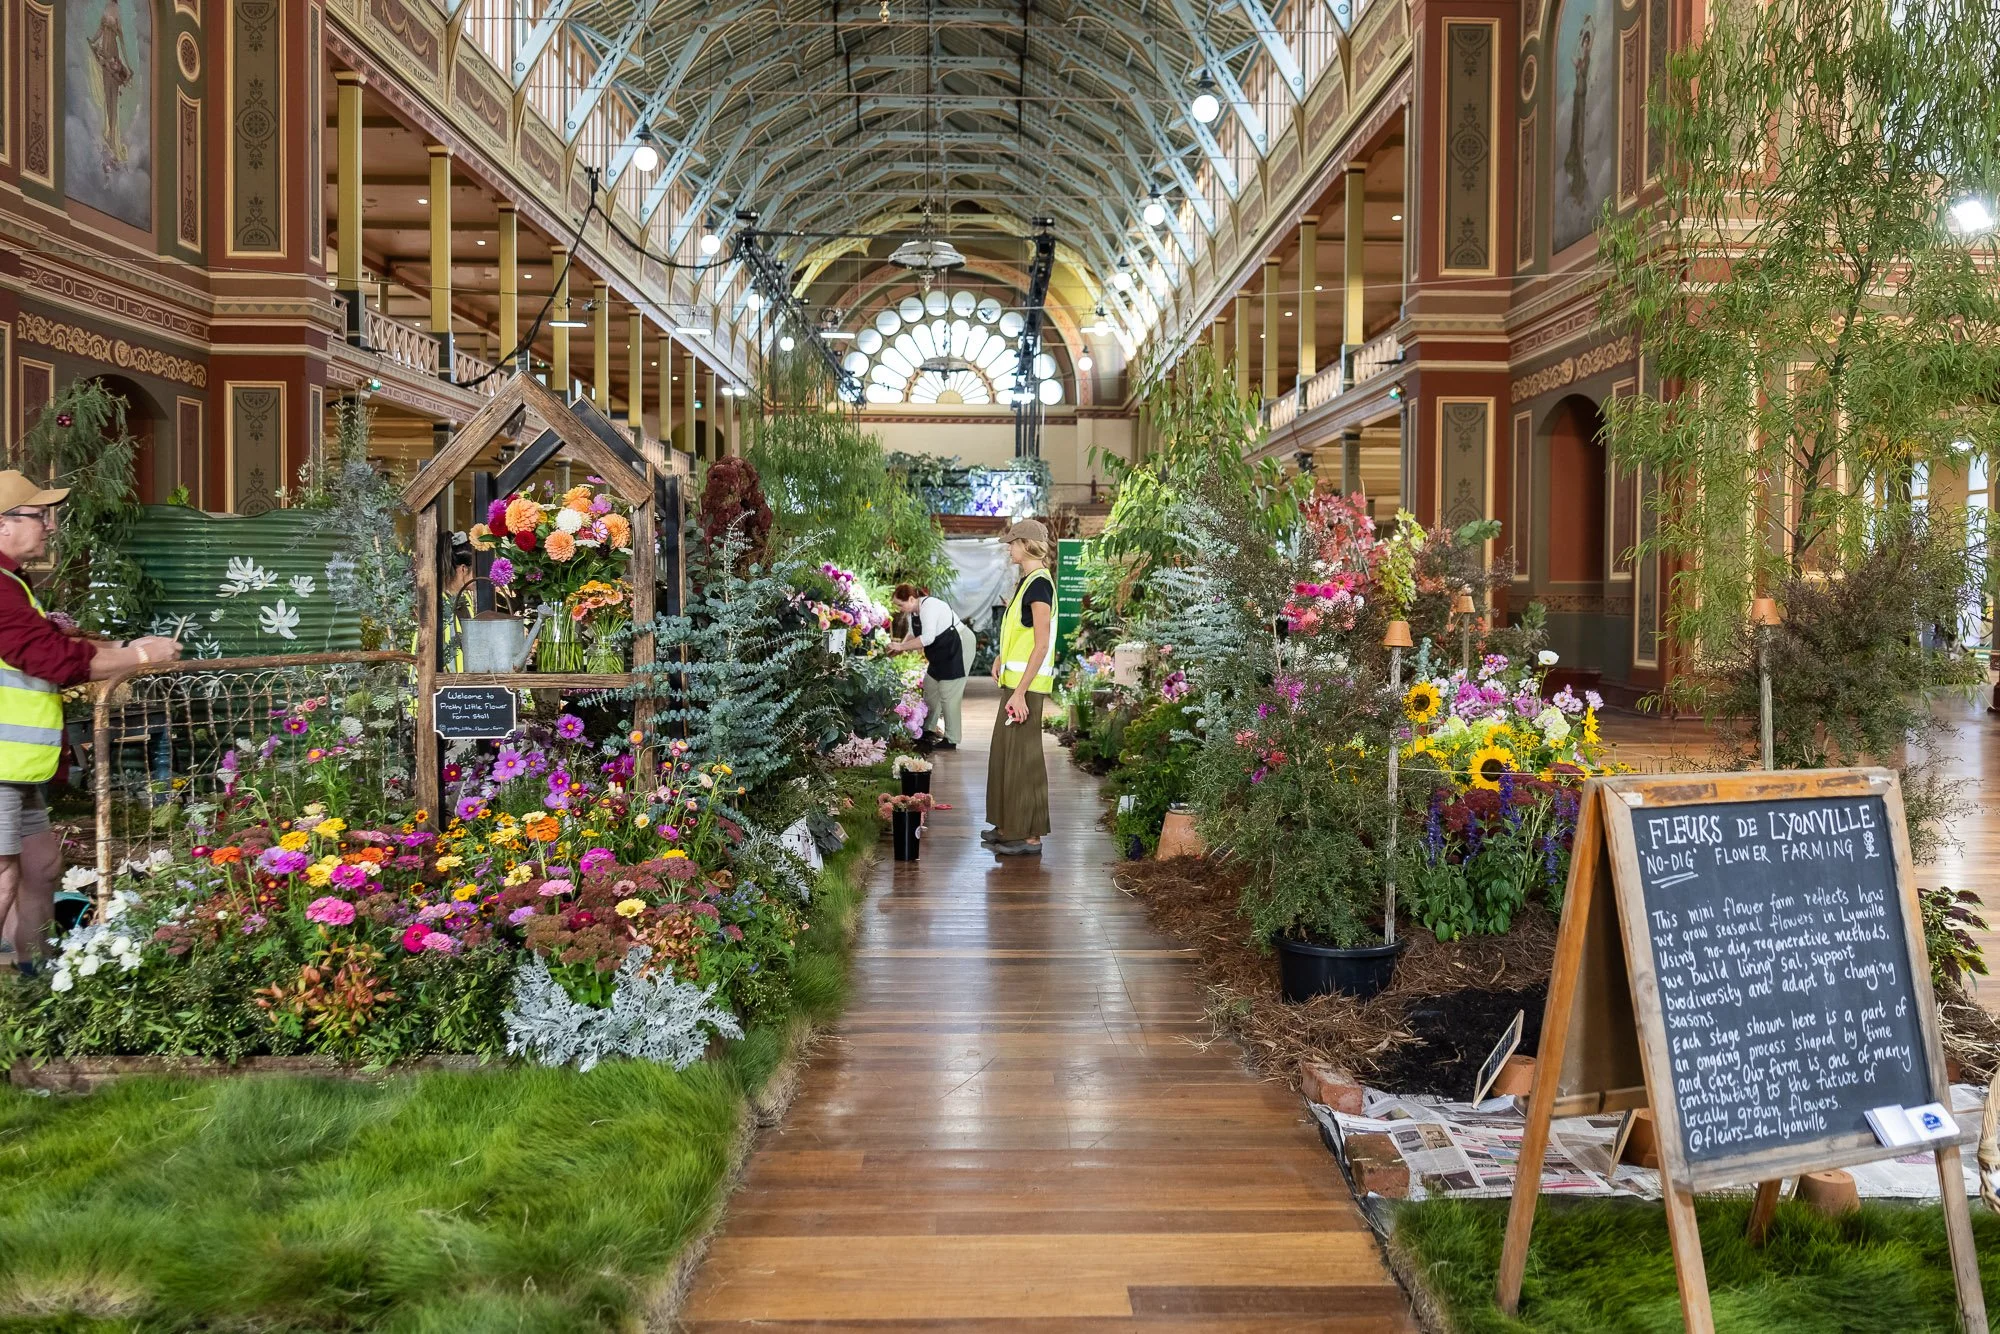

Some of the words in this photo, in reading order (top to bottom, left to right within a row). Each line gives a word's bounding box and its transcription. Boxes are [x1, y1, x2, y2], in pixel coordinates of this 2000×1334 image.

[439, 702, 463, 713] Pretty
[484, 702, 508, 710] Flower
[447, 691, 483, 700] Welcome
[486, 692, 495, 700] to
[1648, 814, 1723, 850] FLEURS
[1736, 818, 1758, 838] DE
[1768, 804, 1875, 841] LYONVILLE
[1714, 844, 1771, 866] FLOWER
[1781, 838, 1854, 863] FARMING
[1652, 909, 1678, 930] This
[1687, 899, 1714, 924] mini
[1722, 896, 1764, 919] flower
[1769, 892, 1795, 913] farm
[1803, 886, 1850, 906] reflects
[1857, 883, 1884, 904] how
[1653, 932, 1674, 947] we
[1682, 925, 1708, 958] grow
[1715, 916, 1763, 939] seasonal
[1769, 913, 1814, 934] flowers
[1822, 908, 1836, 924] in
[1840, 903, 1886, 929] Lyonville
[1660, 949, 1696, 970] Using
[1834, 922, 1890, 943] methods.
[1661, 974, 1684, 989] we
[1690, 959, 1729, 986] build
[1737, 957, 1775, 985] living
[1811, 944, 1855, 968] support
[1665, 982, 1742, 1010] biodiversity
[1748, 975, 1772, 998] and
[1782, 972, 1818, 996] adapt
[1824, 966, 1836, 985] to
[1844, 959, 1897, 991] changing
[1672, 1031, 1702, 1055] Each
[1709, 1026, 1741, 1051] stage
[1745, 1014, 1786, 1037] shown
[1790, 1009, 1817, 1031] here
[1825, 1005, 1837, 1026] is
[1844, 1009, 1855, 1024] a
[1861, 999, 1887, 1033] part
[1895, 995, 1908, 1018] of
[1675, 1058, 1690, 1073] an
[1696, 1047, 1741, 1078] ongoing
[1748, 1039, 1787, 1070] process
[1794, 1027, 1837, 1053] shaped
[1843, 1026, 1858, 1051] by
[1866, 1023, 1893, 1043] time
[1678, 1070, 1704, 1095] and
[1742, 1063, 1765, 1085] Our
[1768, 1056, 1802, 1081] farm
[1807, 1052, 1821, 1072] is
[1828, 1052, 1850, 1070] one
[1857, 1043, 1871, 1065] of
[1873, 1044, 1913, 1073] many
[1679, 1083, 1761, 1112] contributing
[1766, 1079, 1781, 1101] to
[1787, 1073, 1812, 1094] the
[1815, 1067, 1860, 1091] future
[1863, 1061, 1879, 1084] of
[1684, 1105, 1729, 1130] locally
[1737, 1104, 1783, 1131] grown
[1788, 1091, 1842, 1119] flowers.
